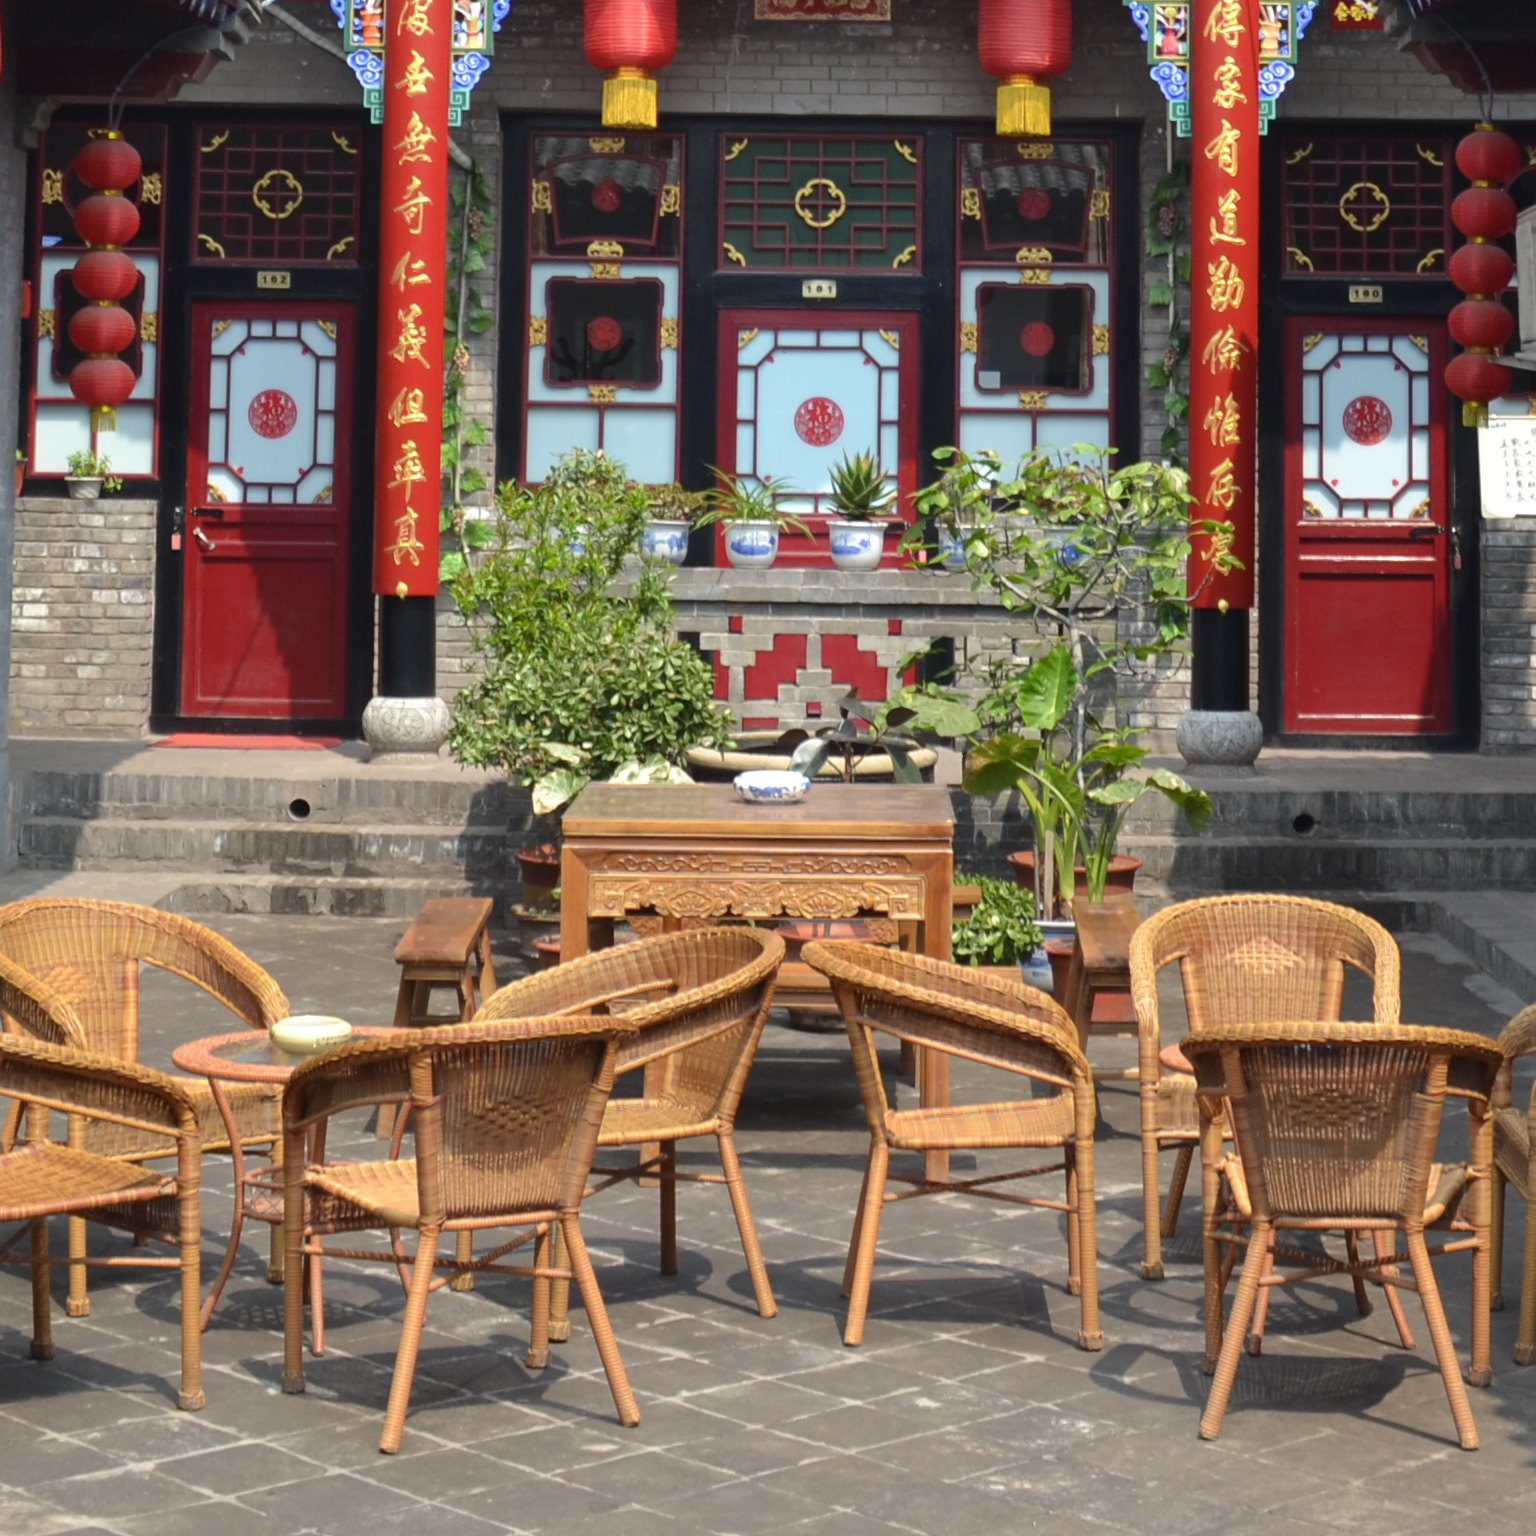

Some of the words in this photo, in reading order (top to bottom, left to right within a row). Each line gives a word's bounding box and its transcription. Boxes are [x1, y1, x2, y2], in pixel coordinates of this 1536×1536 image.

[262, 275, 287, 284] 102
[807, 285, 832, 294] 101
[1354, 289, 1380, 299] 100
